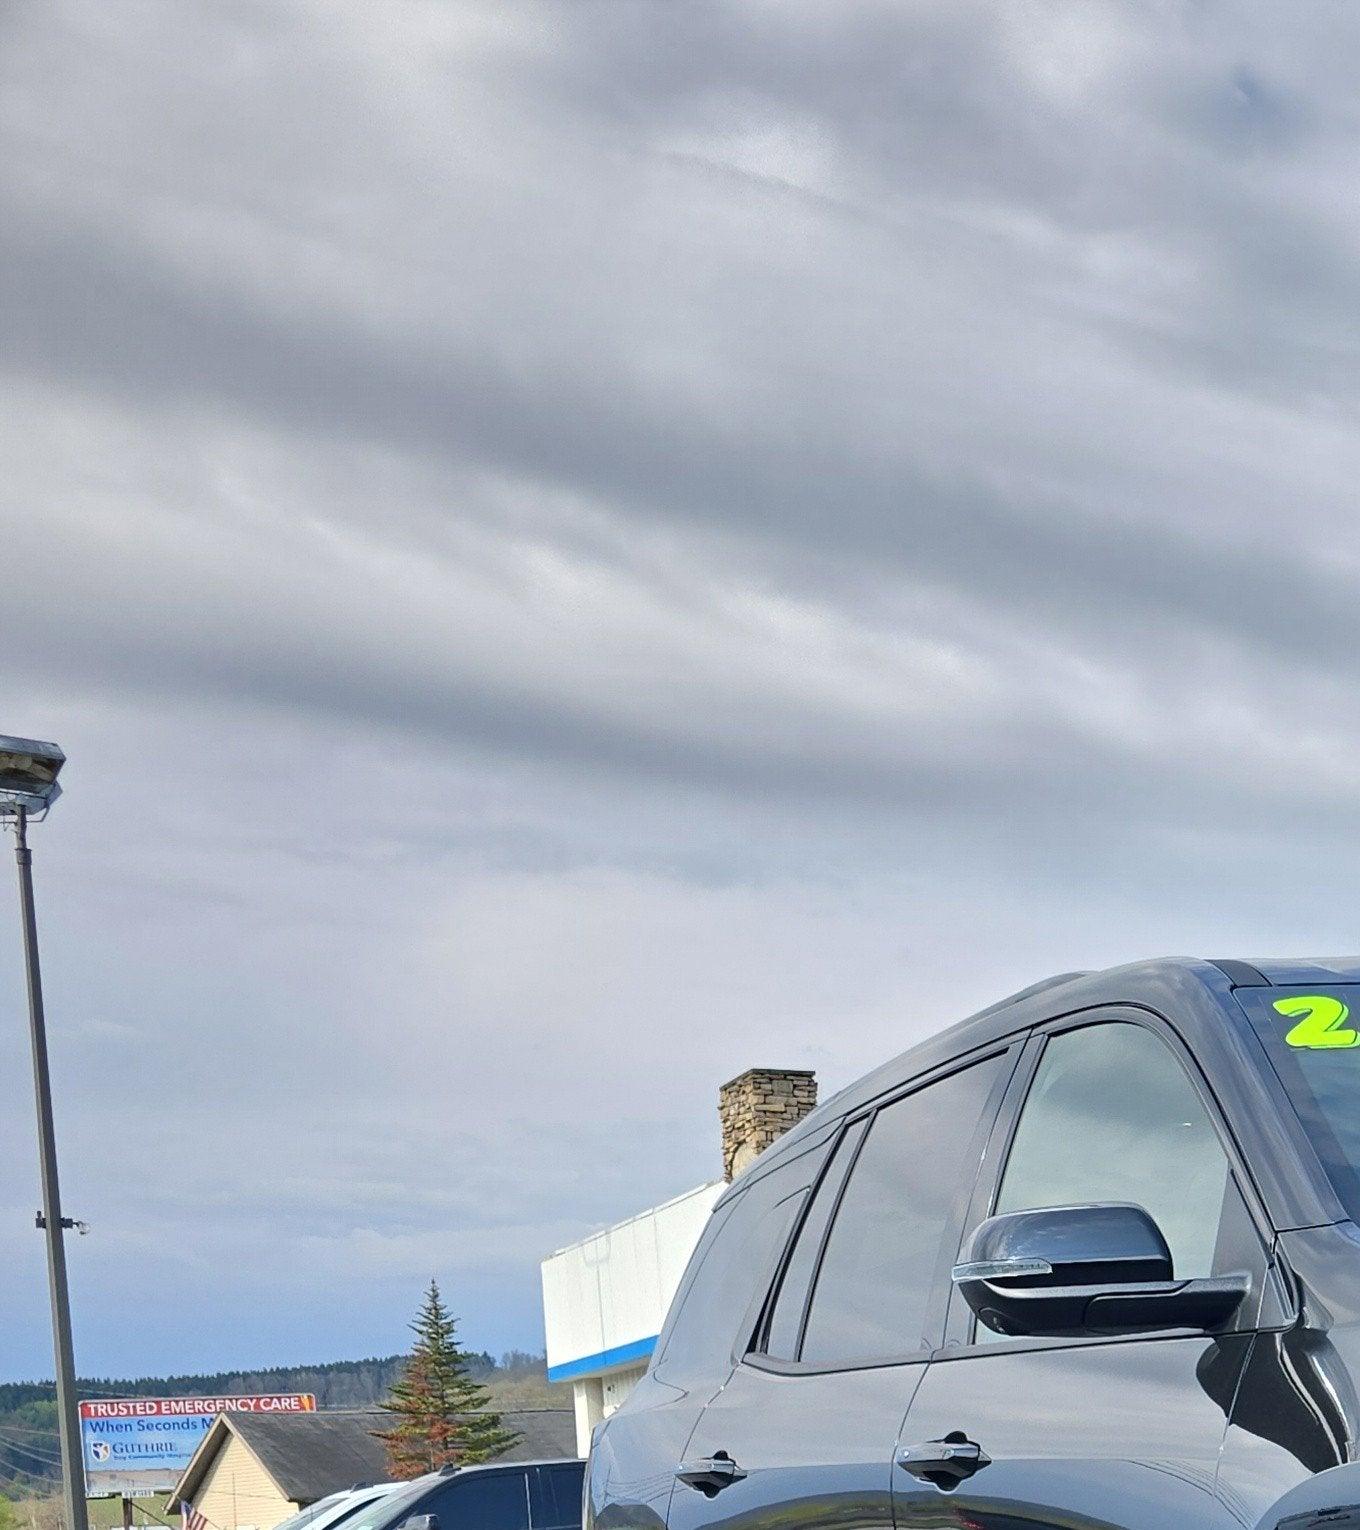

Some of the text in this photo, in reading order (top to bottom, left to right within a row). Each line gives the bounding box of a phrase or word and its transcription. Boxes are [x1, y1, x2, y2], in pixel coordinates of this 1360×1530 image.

[89, 1397, 301, 1416] TRUSTED EMERGENCY CARE
[90, 1420, 133, 1433] When
[137, 1418, 198, 1431] Seconds
